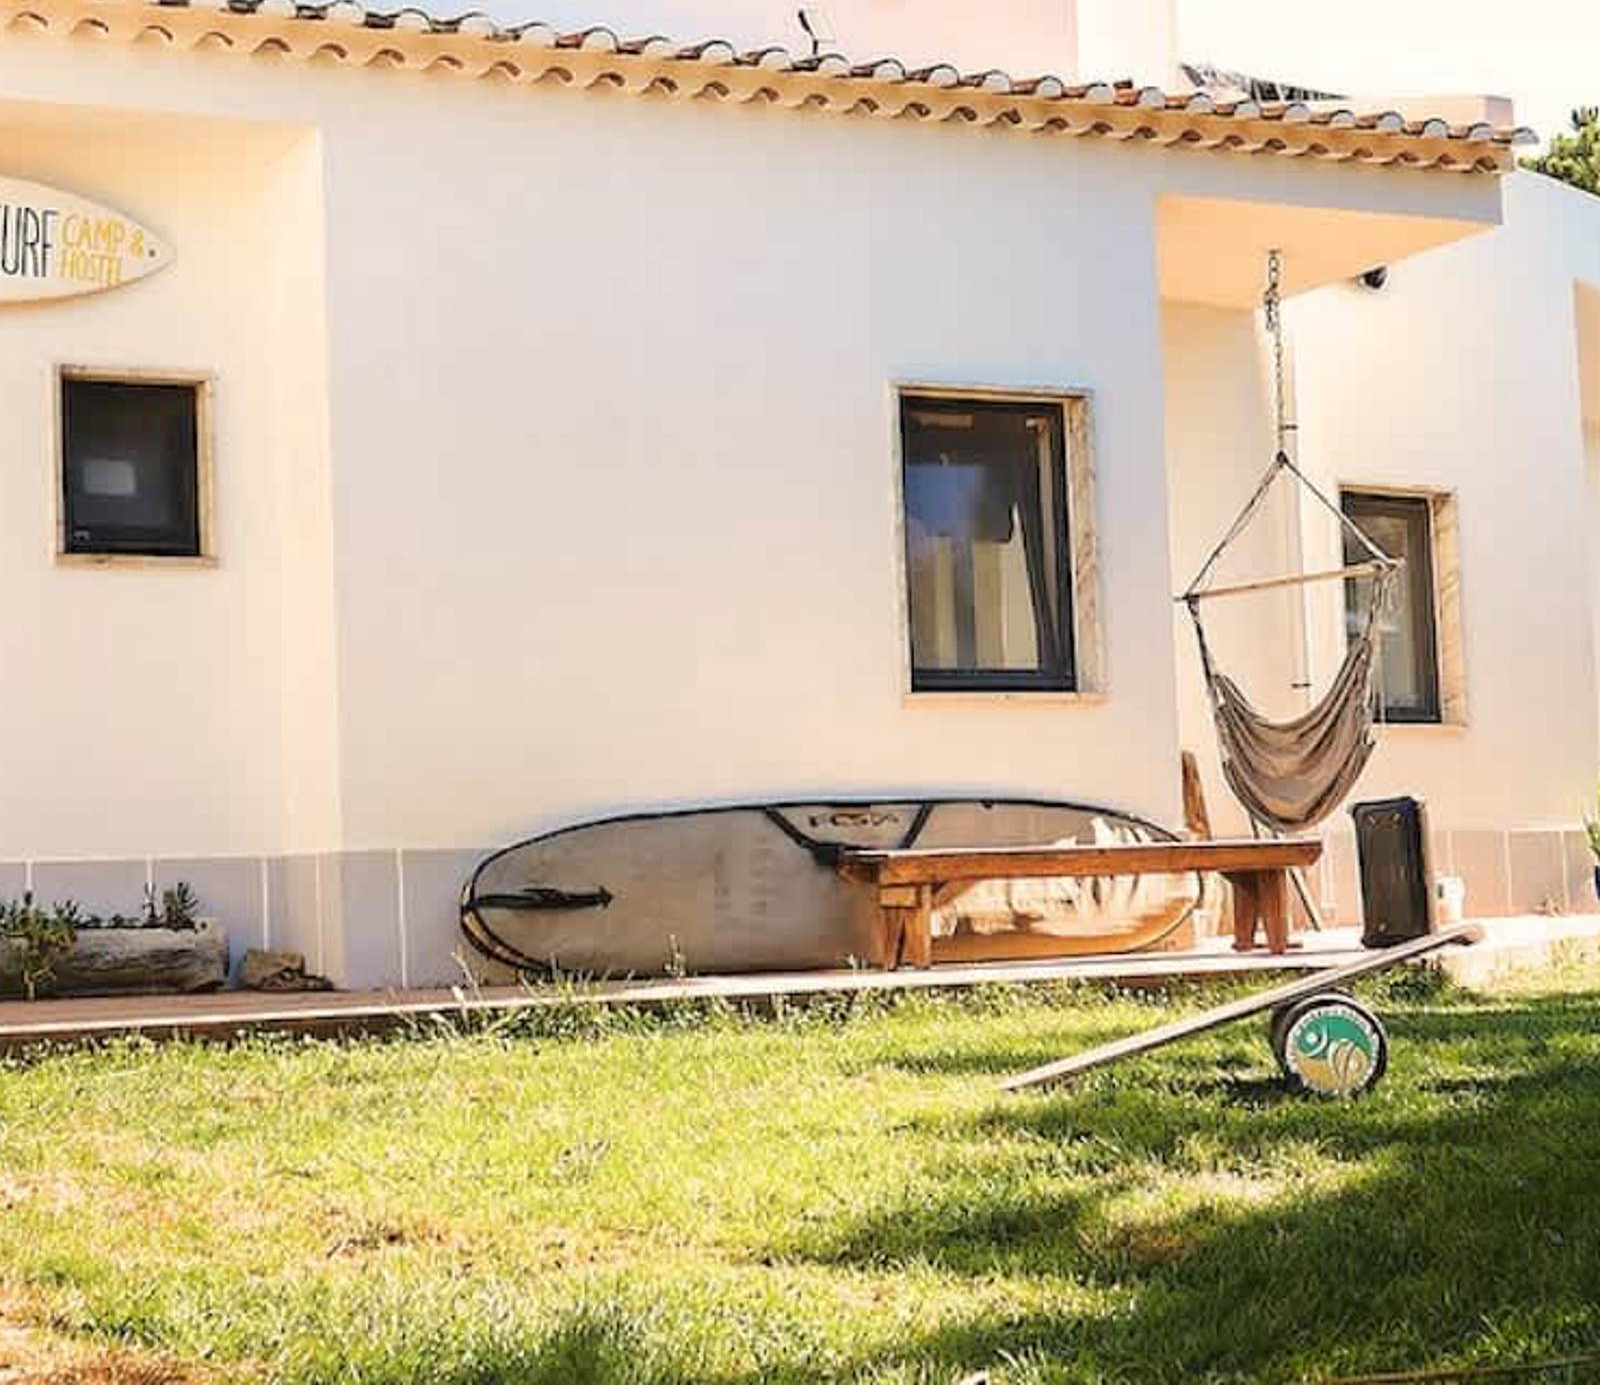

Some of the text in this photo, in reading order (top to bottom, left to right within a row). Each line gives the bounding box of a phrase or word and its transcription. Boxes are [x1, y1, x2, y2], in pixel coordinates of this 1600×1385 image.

[0, 204, 59, 277] URF
[62, 215, 144, 259] CAMP &
